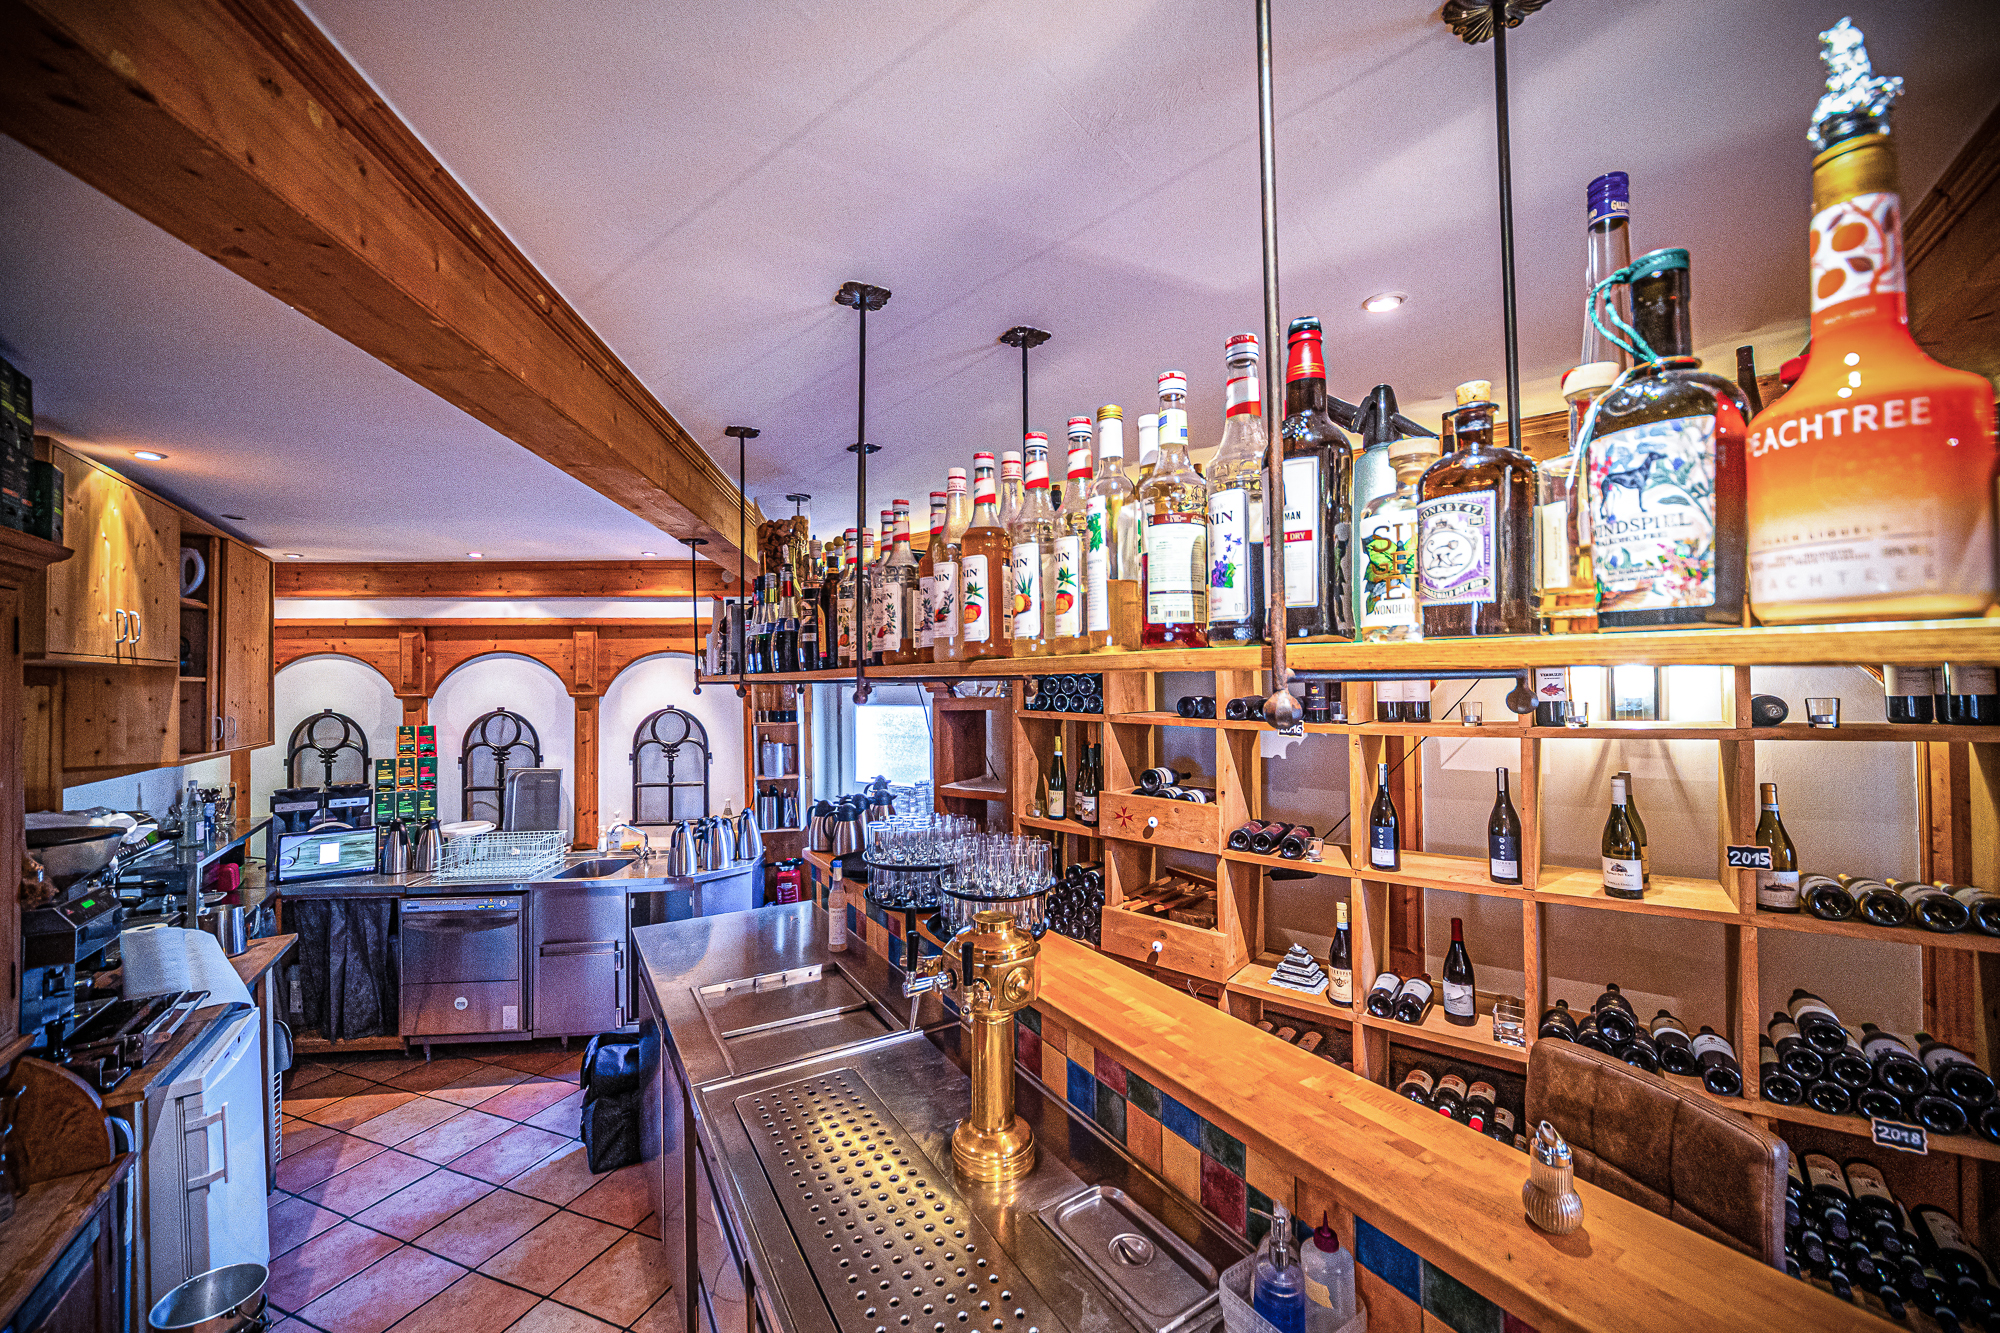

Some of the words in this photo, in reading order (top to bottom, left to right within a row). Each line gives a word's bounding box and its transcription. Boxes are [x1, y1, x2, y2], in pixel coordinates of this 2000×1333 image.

[1464, 503, 1482, 515] 47
[1209, 510, 1233, 525] NIN
[1290, 532, 1305, 540] DRY
[1729, 850, 1771, 866] 2015
[1877, 1125, 1922, 1146] 2018
